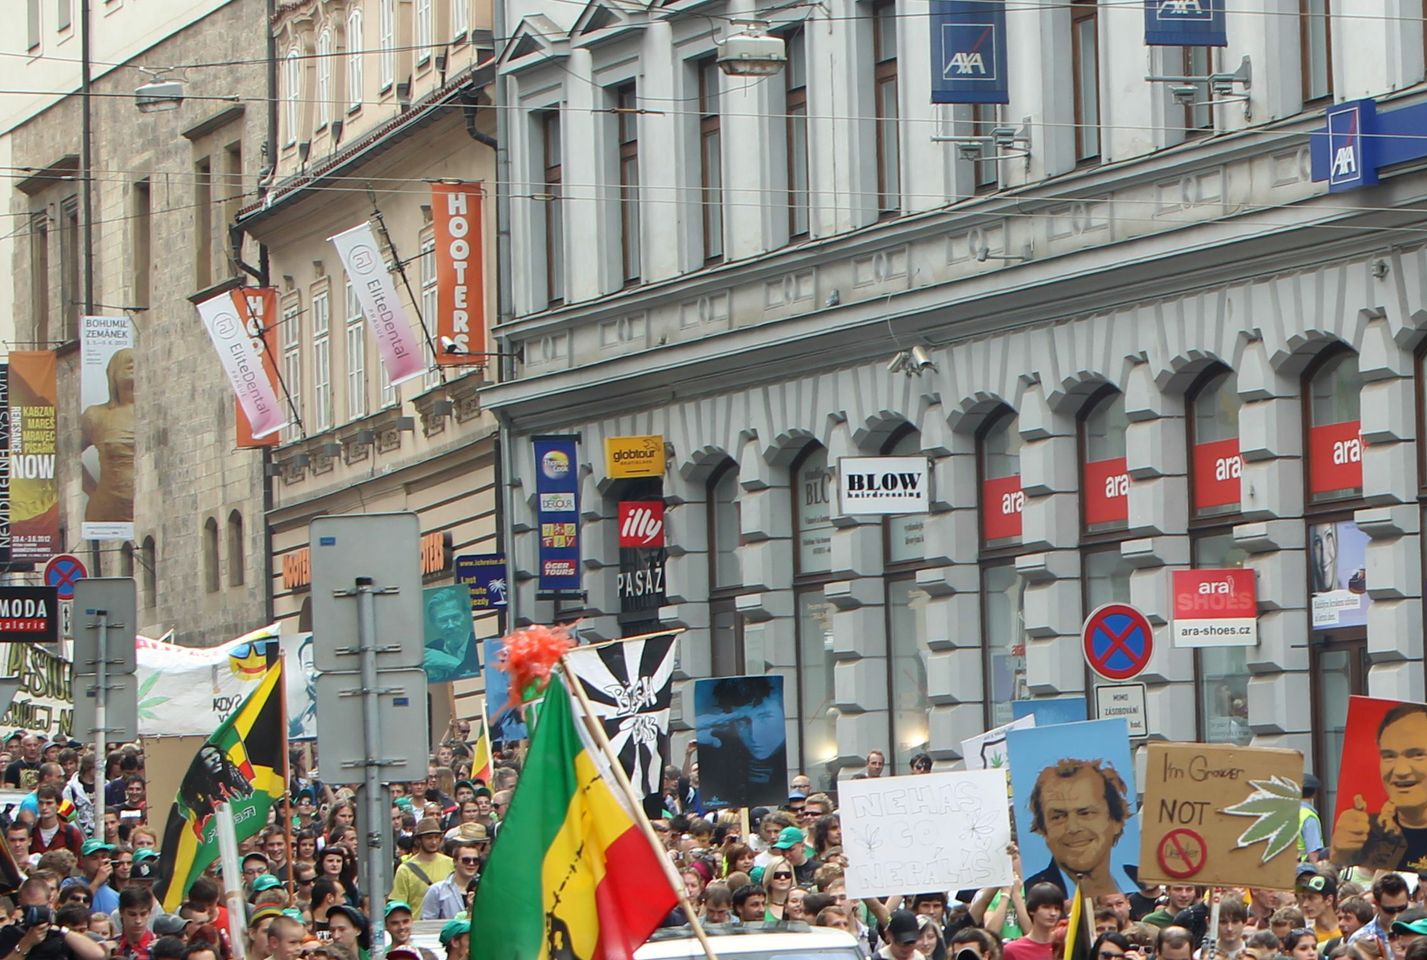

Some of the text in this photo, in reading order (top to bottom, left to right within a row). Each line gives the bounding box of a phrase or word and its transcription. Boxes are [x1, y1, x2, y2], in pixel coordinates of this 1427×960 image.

[943, 52, 986, 74] AXA
[1331, 145, 1356, 177] AXA
[447, 191, 470, 356] HOOTERS
[86, 319, 128, 328] BOHUMIL
[366, 278, 410, 360] EliteDental
[86, 328, 128, 338] ZEMÁNEK
[229, 343, 270, 416] EliteDental
[11, 406, 21, 454] RENESANCE
[613, 448, 655, 462] globtour
[1333, 438, 1361, 465] ara
[11, 455, 56, 479] NOW
[553, 464, 569, 473] Cook
[1215, 455, 1241, 481] ara
[847, 472, 922, 491] BLOW
[1105, 472, 1129, 498] ara
[1002, 489, 1025, 515] ara
[622, 508, 662, 544] illy
[544, 568, 575, 576] TOURS
[616, 561, 664, 598] PASÁŽ
[1199, 580, 1230, 595] ara
[0, 599, 47, 618] MODA
[1177, 592, 1251, 610] SHOES
[1181, 624, 1251, 637] ara-shoes.cz
[1104, 705, 1139, 716] ZÁSOBOVÁNÍ
[1158, 799, 1212, 825] NOT
